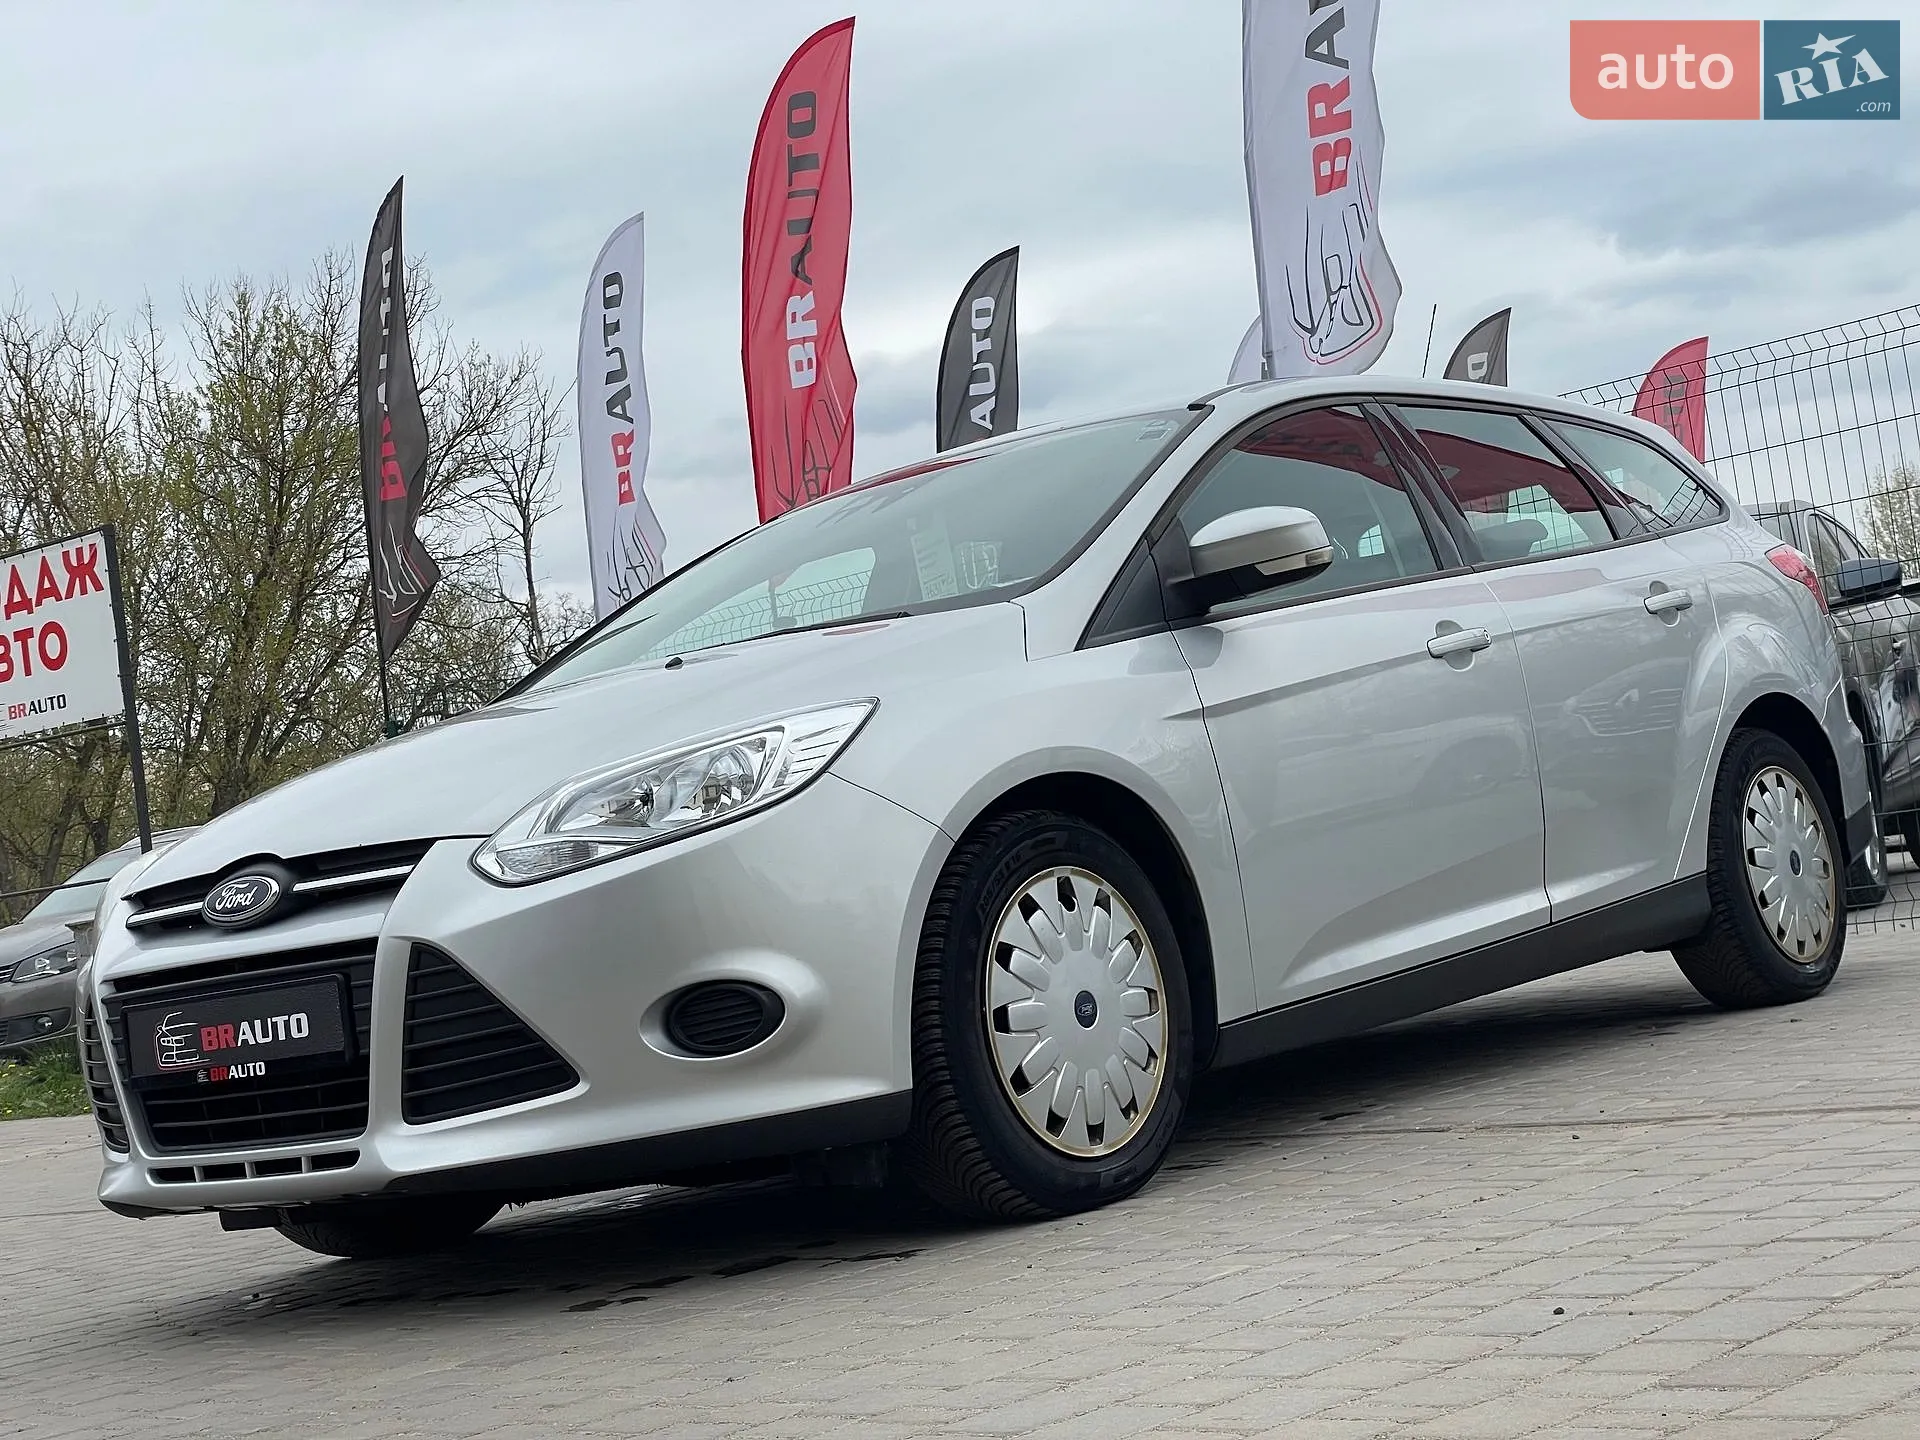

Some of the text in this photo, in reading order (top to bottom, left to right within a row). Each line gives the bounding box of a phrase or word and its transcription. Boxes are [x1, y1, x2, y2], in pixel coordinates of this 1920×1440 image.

[1305, 0, 1352, 196] BRA
[786, 90, 821, 391] BRAUTO
[603, 271, 636, 506] BRAUTO
[969, 295, 995, 440] AUTO
[0, 543, 105, 620] ДАЖ
[8, 693, 67, 720] BRAUTO
[216, 882, 259, 911] Ford
[200, 1012, 310, 1052] BRAUTO
[210, 1061, 266, 1082] BRAUTO
